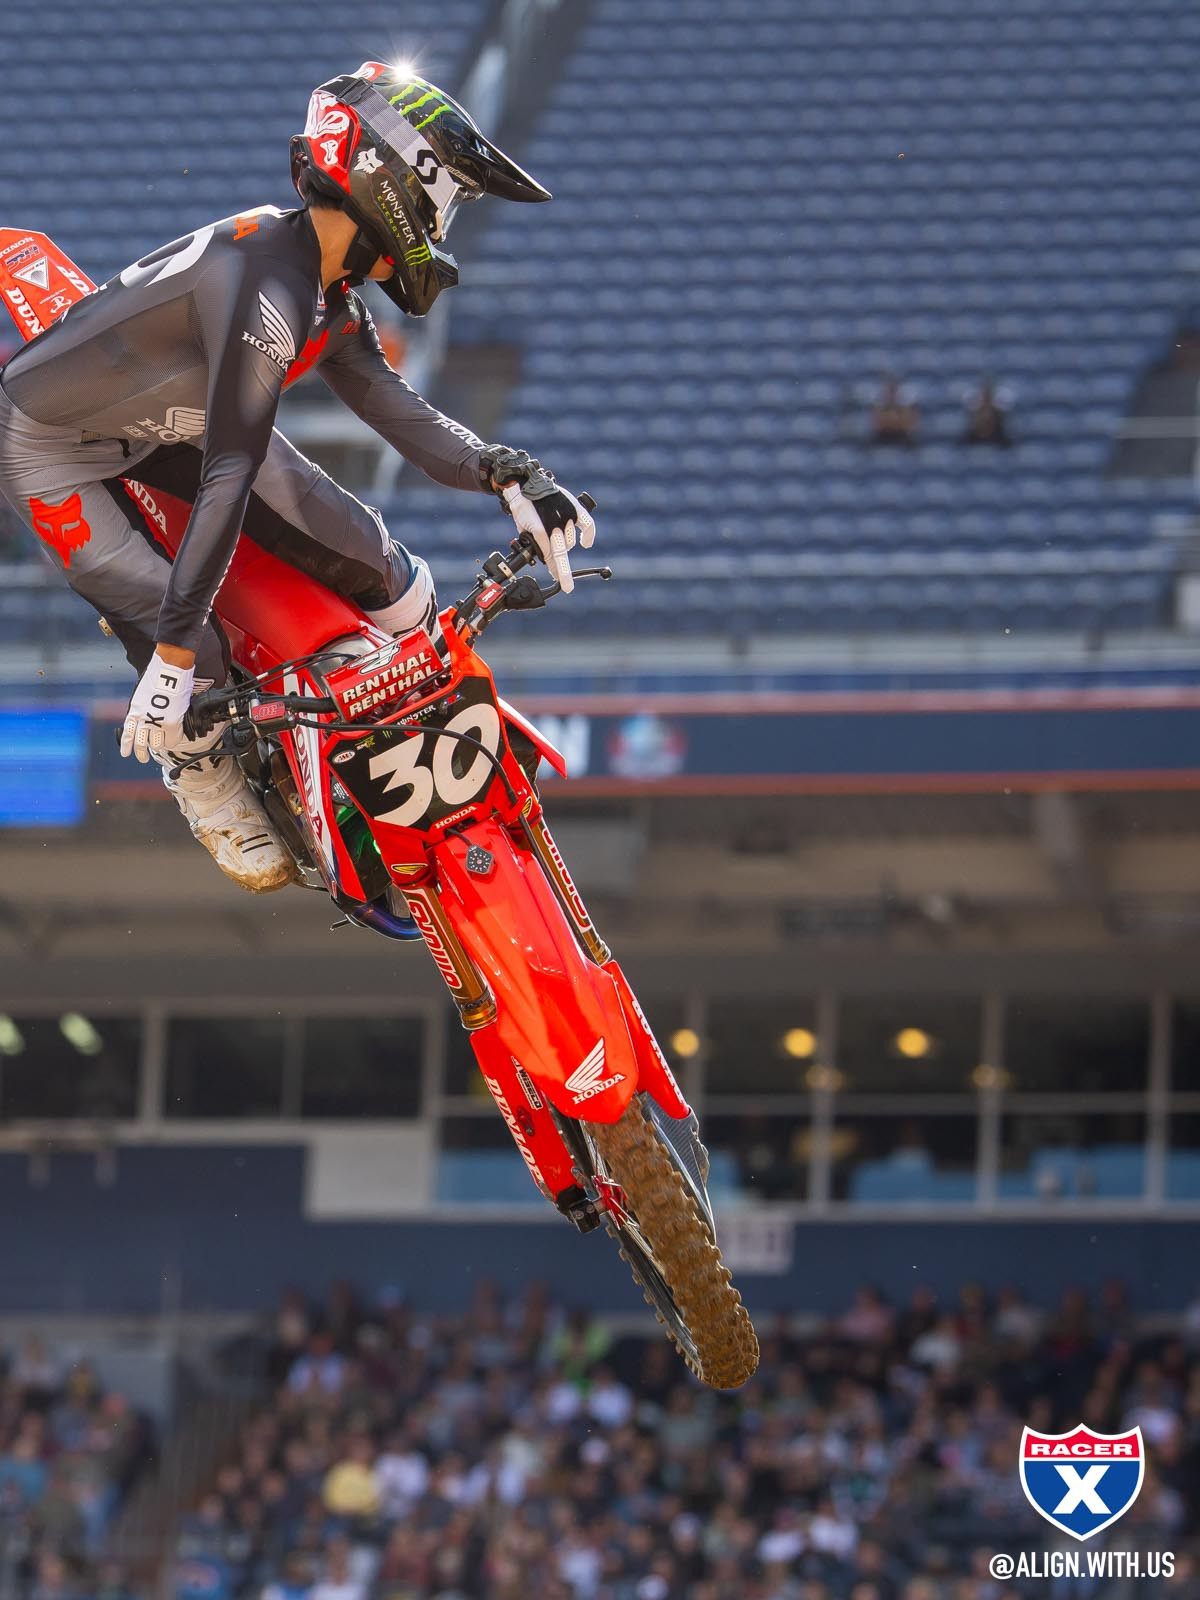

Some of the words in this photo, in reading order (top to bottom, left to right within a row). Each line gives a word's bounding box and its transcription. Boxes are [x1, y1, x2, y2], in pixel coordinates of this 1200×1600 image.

[377, 195, 400, 238] ENERGY
[380, 180, 416, 244] MONSTER
[241, 331, 289, 374] HONDA
[144, 673, 178, 728] FOX
[342, 651, 432, 704] RENTHAL
[349, 664, 438, 718] RENTHAL
[368, 703, 500, 828] 30
[434, 805, 478, 830] HONDA
[572, 1073, 627, 1105] HONDA
[484, 1074, 545, 1186] DUNLOP
